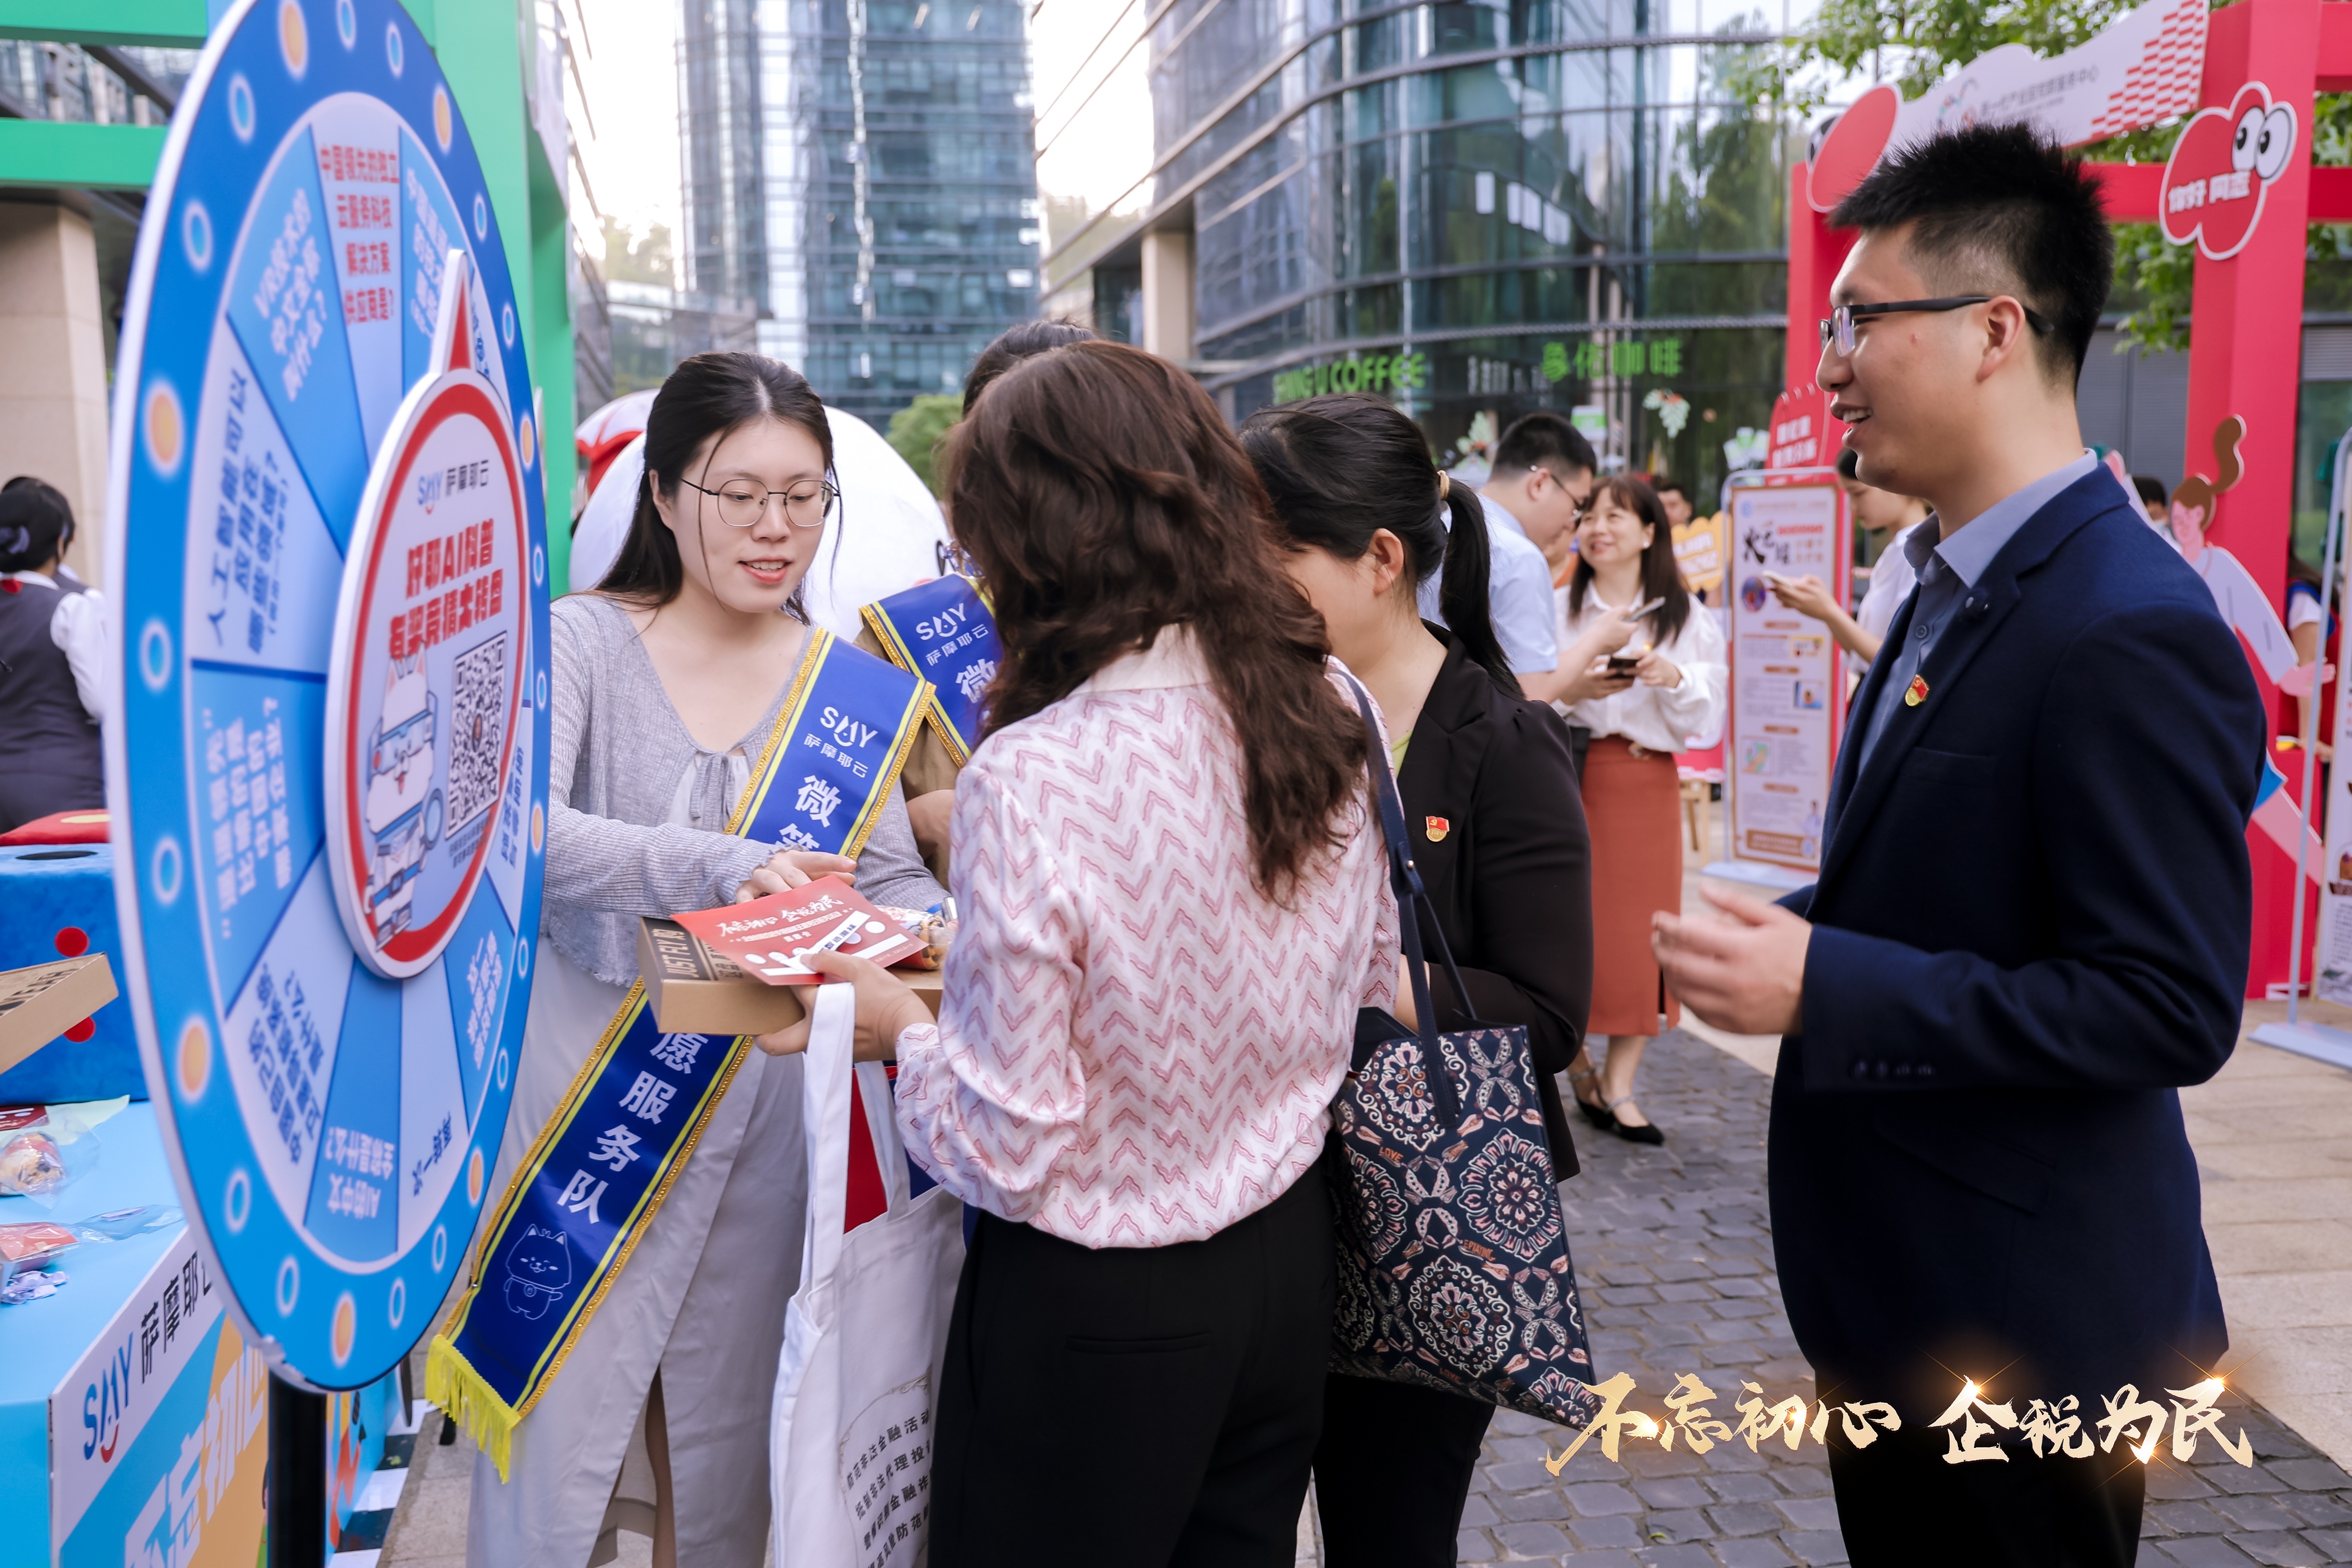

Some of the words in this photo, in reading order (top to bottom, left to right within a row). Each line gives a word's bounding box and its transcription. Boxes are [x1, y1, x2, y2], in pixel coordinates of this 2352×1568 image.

[336, 195, 392, 230] 云服务科技
[2168, 178, 2206, 213] 你好
[2209, 171, 2251, 203] 同志
[346, 241, 392, 277] 解决方案
[1329, 352, 1426, 395] COFFEE
[207, 368, 248, 648] 人工智能可以
[231, 453, 261, 597] 应用在
[389, 569, 503, 661] 有奖竞猜大转盘
[925, 623, 989, 666] 萨摩耶云
[803, 733, 869, 779] 萨摩耶云
[247, 729, 269, 860] 中国的
[781, 894, 845, 923] 企税为民
[656, 939, 691, 955] FLY
[661, 954, 700, 978] JUST
[556, 1032, 710, 1225] 愿服务队
[412, 1111, 452, 1196] 再转一次
[1379, 1146, 1403, 1162] LOVE
[863, 1474, 931, 1551] 警惕识别金融诈
